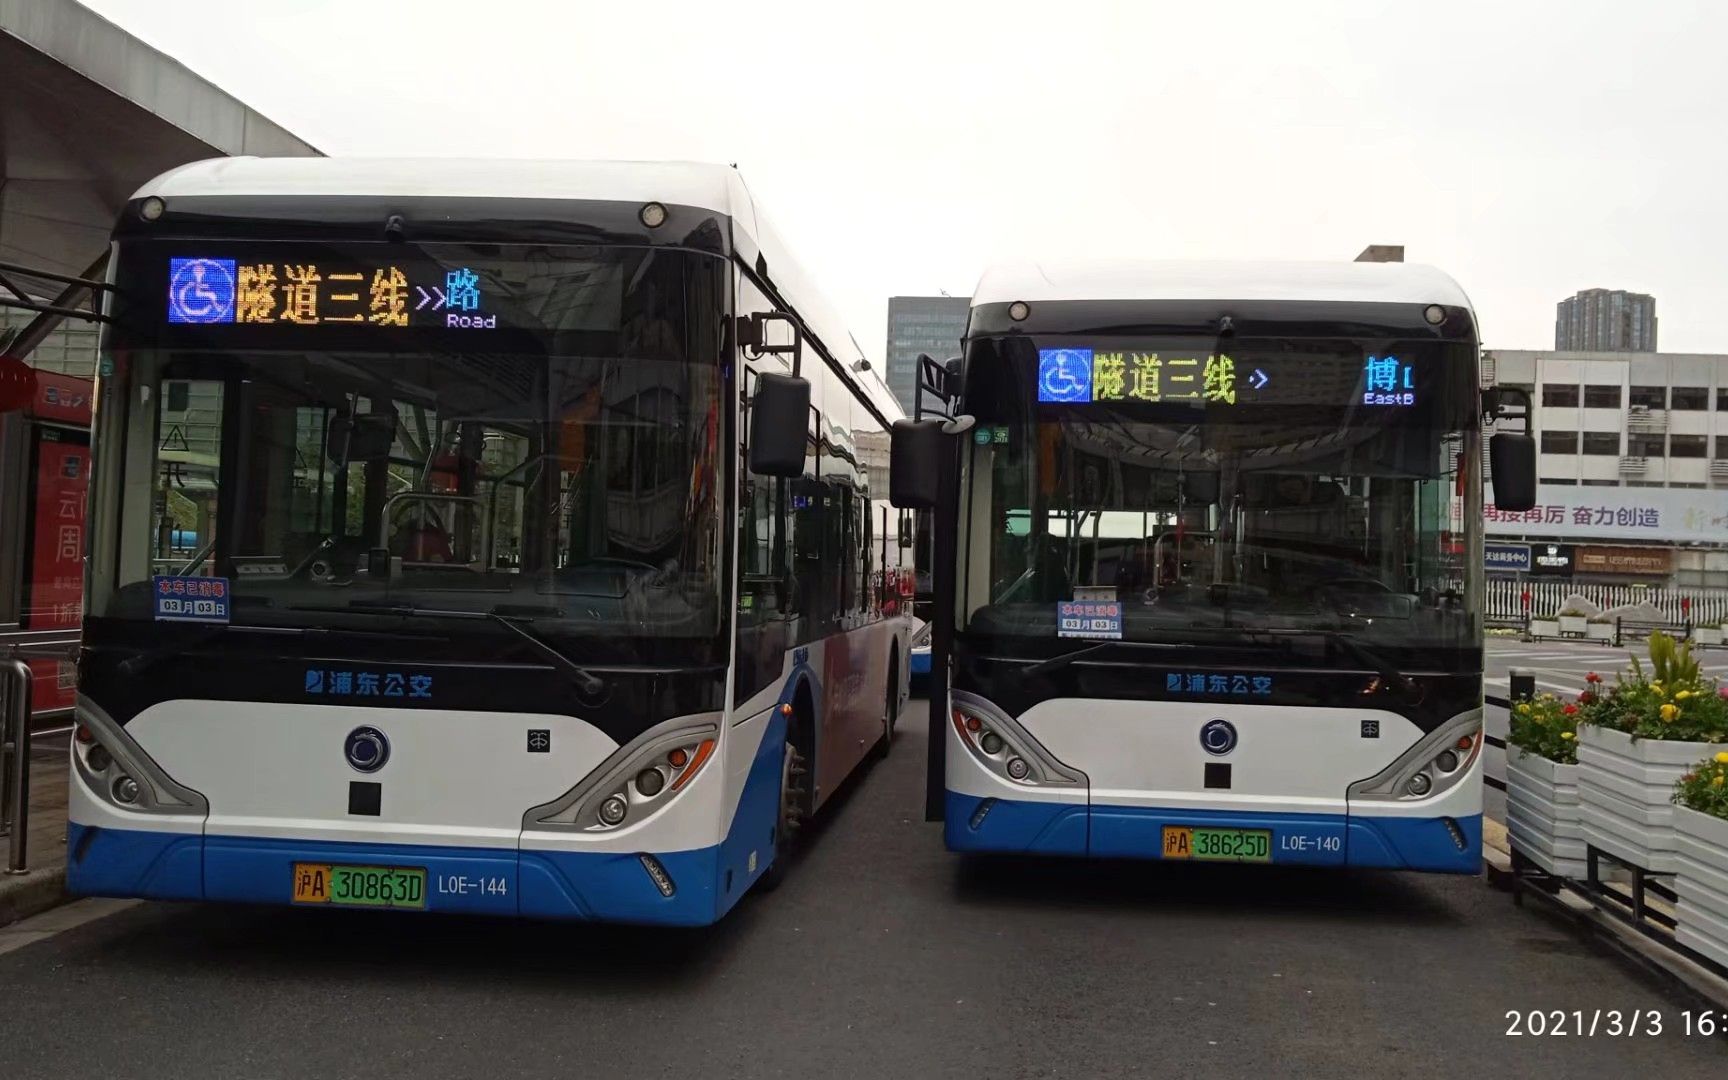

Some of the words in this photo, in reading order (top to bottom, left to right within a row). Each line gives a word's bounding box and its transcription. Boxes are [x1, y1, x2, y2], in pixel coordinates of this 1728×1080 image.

[236, 264, 409, 326] 隧道三线
[446, 267, 480, 311] 路
[446, 313, 496, 329] Road
[1092, 352, 1236, 404] 隧道三线
[1572, 505, 1660, 528] 奋力创造
[159, 579, 225, 598] 本车已消毒
[164, 600, 225, 616] 03月03日
[1065, 619, 1118, 630] 03月03日
[329, 671, 433, 697] 浦东公交
[1186, 673, 1272, 694] 浦东公交
[1198, 832, 1268, 857] 38625D
[336, 871, 422, 902] 30863D
